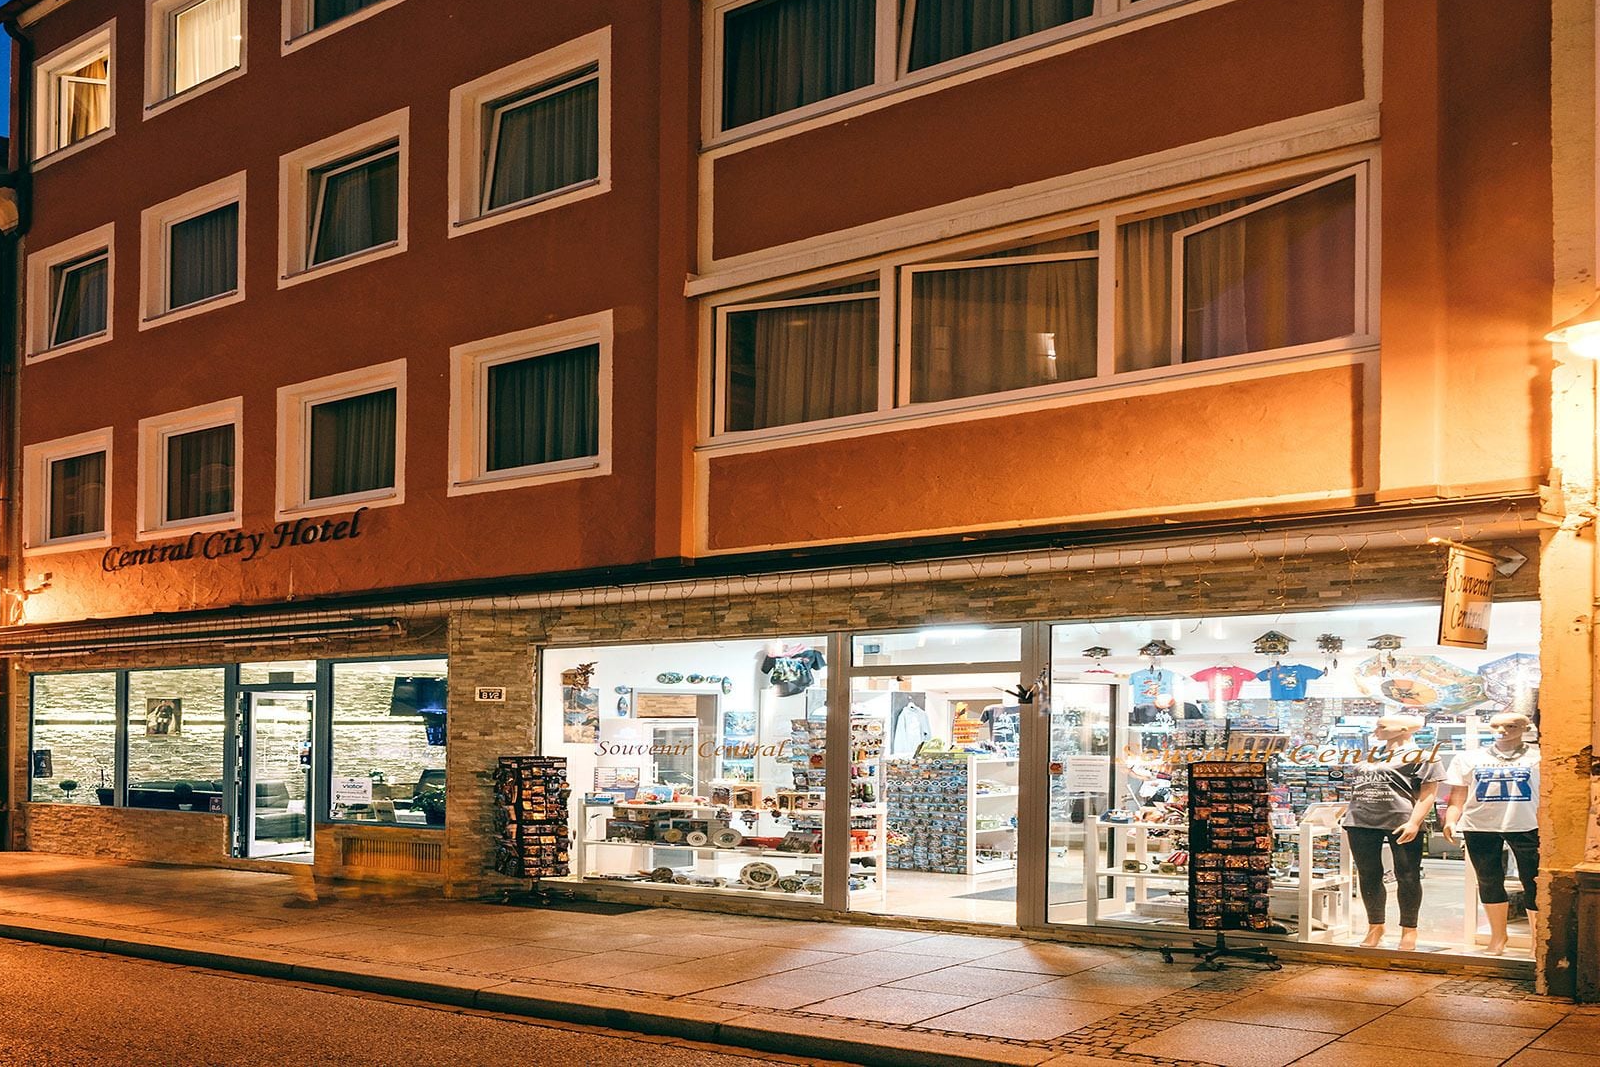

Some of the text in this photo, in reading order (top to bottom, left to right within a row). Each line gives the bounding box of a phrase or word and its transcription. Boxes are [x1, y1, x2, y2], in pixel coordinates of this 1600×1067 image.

[102, 506, 369, 572] Central City Hotel
[1449, 566, 1492, 597] Souvenir
[1450, 602, 1491, 631] Central
[594, 738, 792, 759] Souvenir Central
[1114, 739, 1453, 766] Souvenir Central
